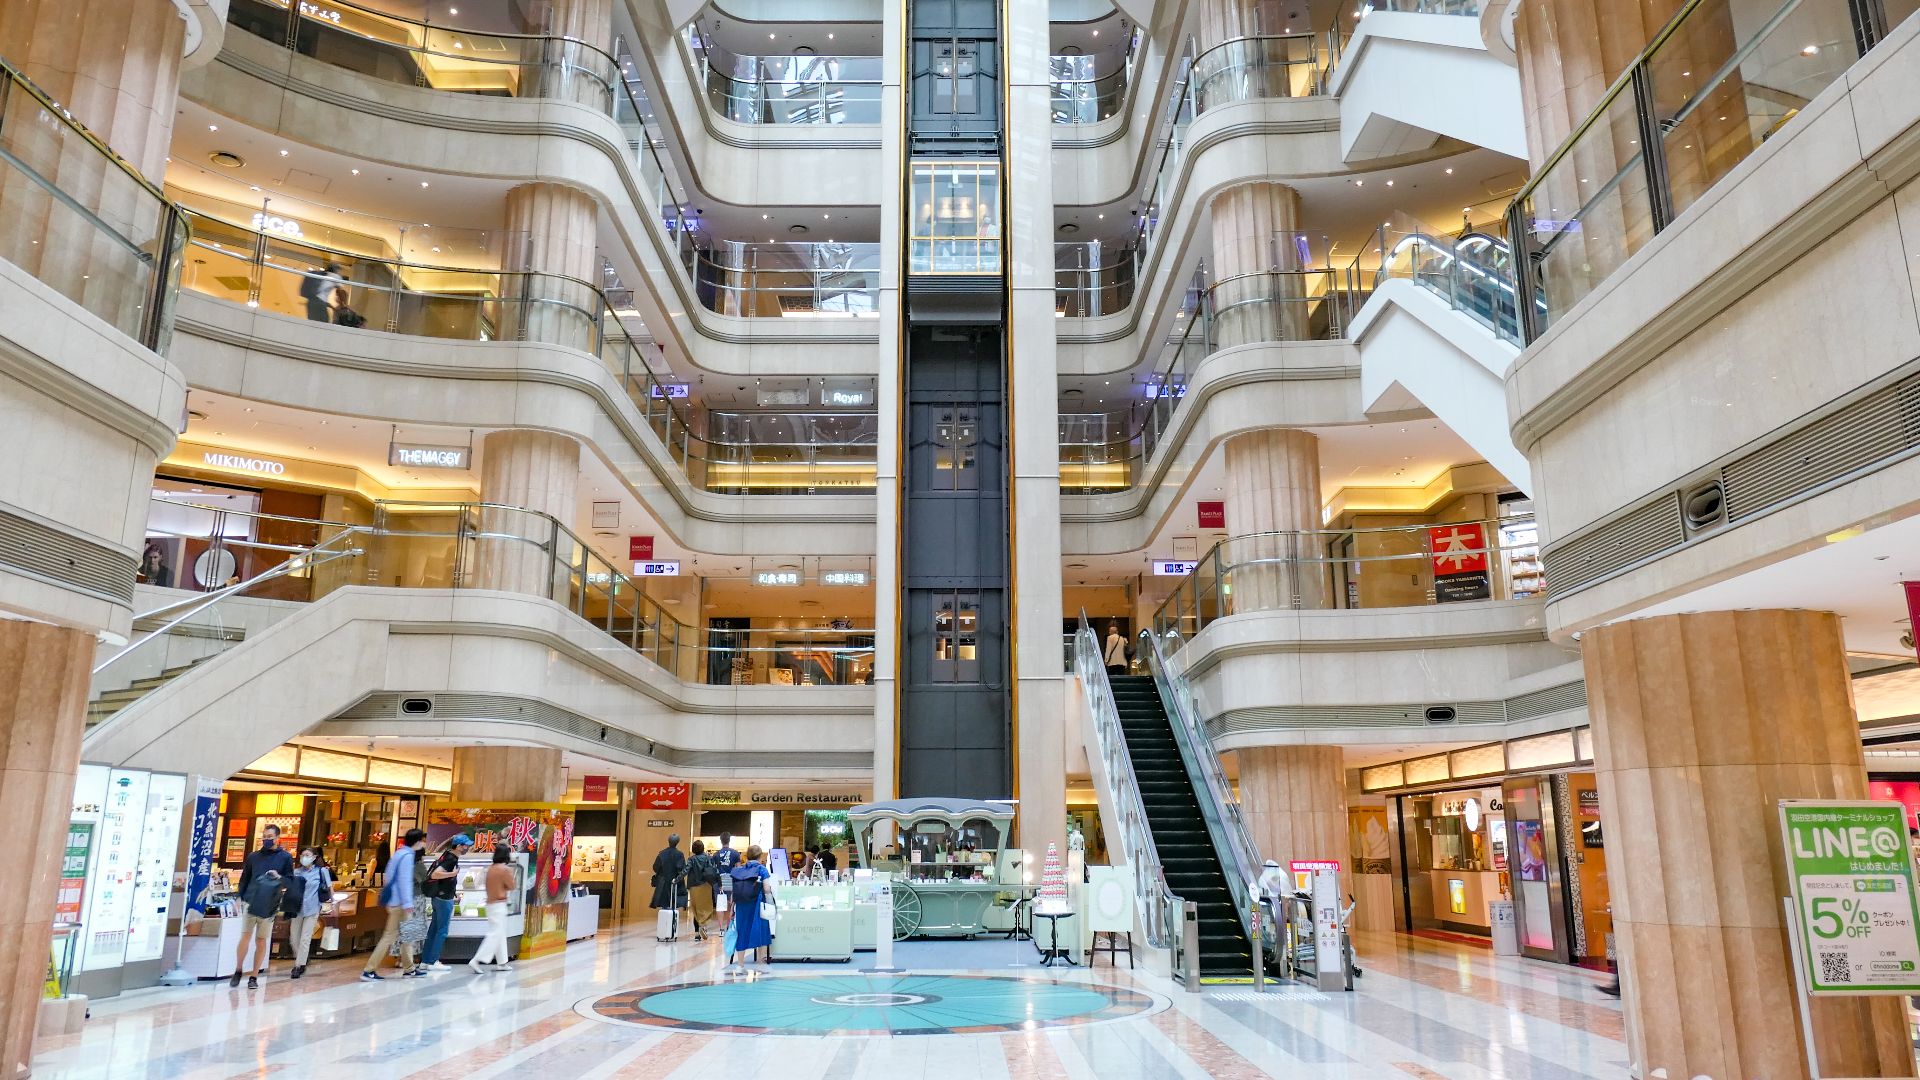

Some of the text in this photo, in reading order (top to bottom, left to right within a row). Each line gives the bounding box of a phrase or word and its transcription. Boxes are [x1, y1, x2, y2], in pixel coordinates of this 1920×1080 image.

[252, 213, 304, 238] ace.
[833, 392, 863, 404] Royal
[203, 452, 285, 476] MIKIMOTO
[1435, 527, 1480, 570] 本
[640, 786, 686, 796] レストラン
[751, 791, 863, 803] Garden Restaurant
[198, 801, 218, 876] 北魚沼産
[1792, 826, 1901, 859] LINE@
[1846, 925, 1872, 939] OFF
